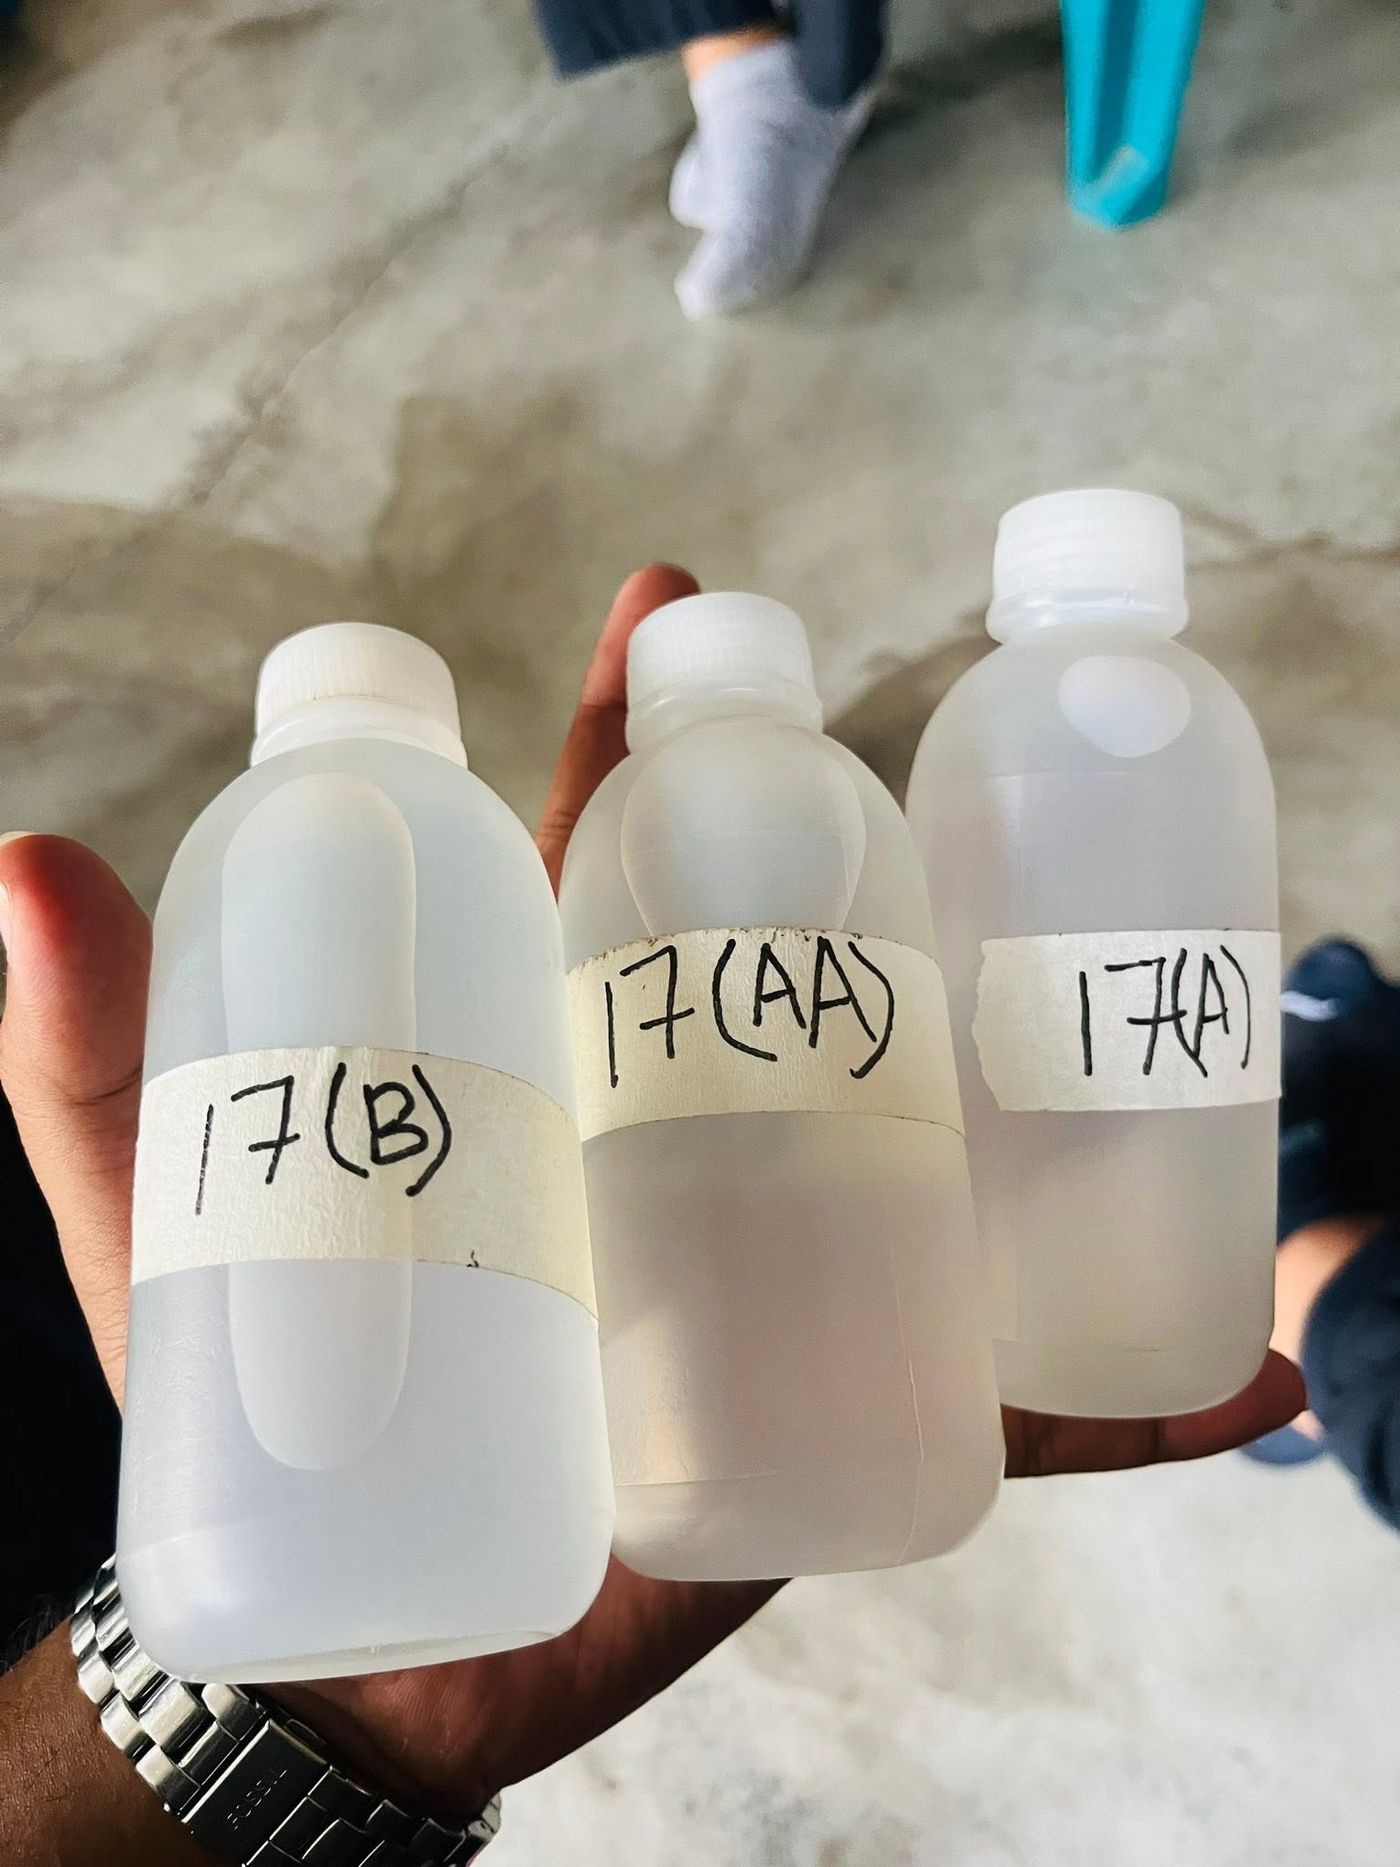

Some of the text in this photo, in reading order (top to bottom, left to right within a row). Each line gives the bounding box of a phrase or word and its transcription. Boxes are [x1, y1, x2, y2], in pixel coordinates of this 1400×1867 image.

[603, 937, 896, 1090] 17(AA)
[1078, 944, 1254, 1079] 17(A)
[195, 1061, 454, 1216] 17(B)
